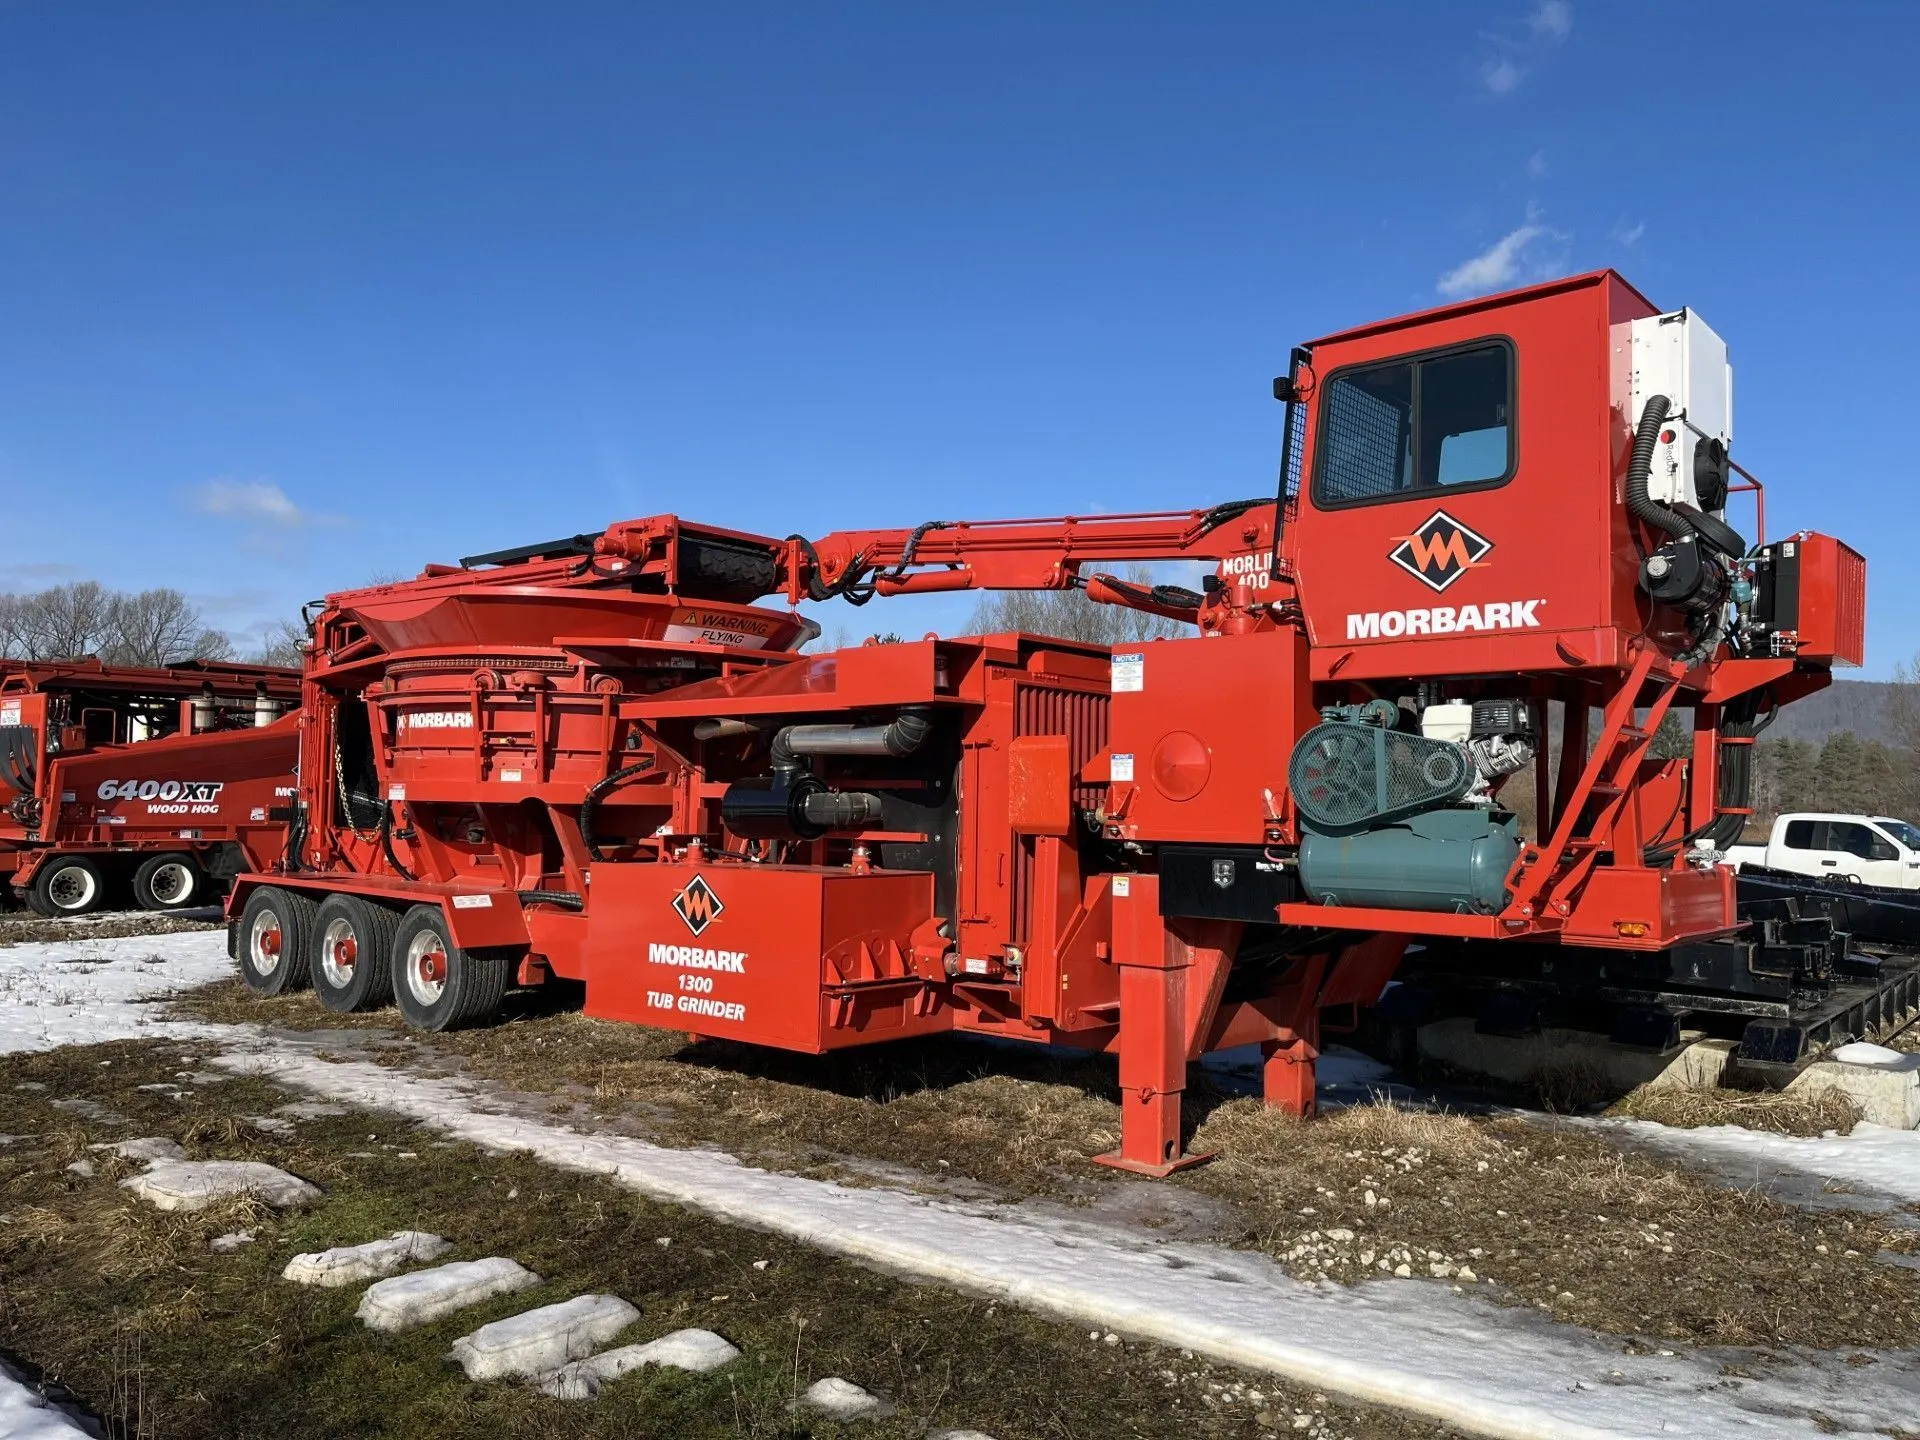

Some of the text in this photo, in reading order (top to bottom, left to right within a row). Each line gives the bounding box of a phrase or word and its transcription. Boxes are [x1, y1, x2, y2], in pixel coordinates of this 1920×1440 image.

[1238, 572, 1269, 590] 400
[701, 614, 769, 634] WARNING
[1347, 599, 1540, 640] MORBARK
[701, 630, 745, 644] FLYING
[97, 779, 222, 802] 6400XT
[147, 804, 219, 814] WOOD HOG
[649, 943, 746, 974] MORBARK
[678, 974, 713, 993] 1300
[647, 990, 746, 1021] TUB GRINDER
